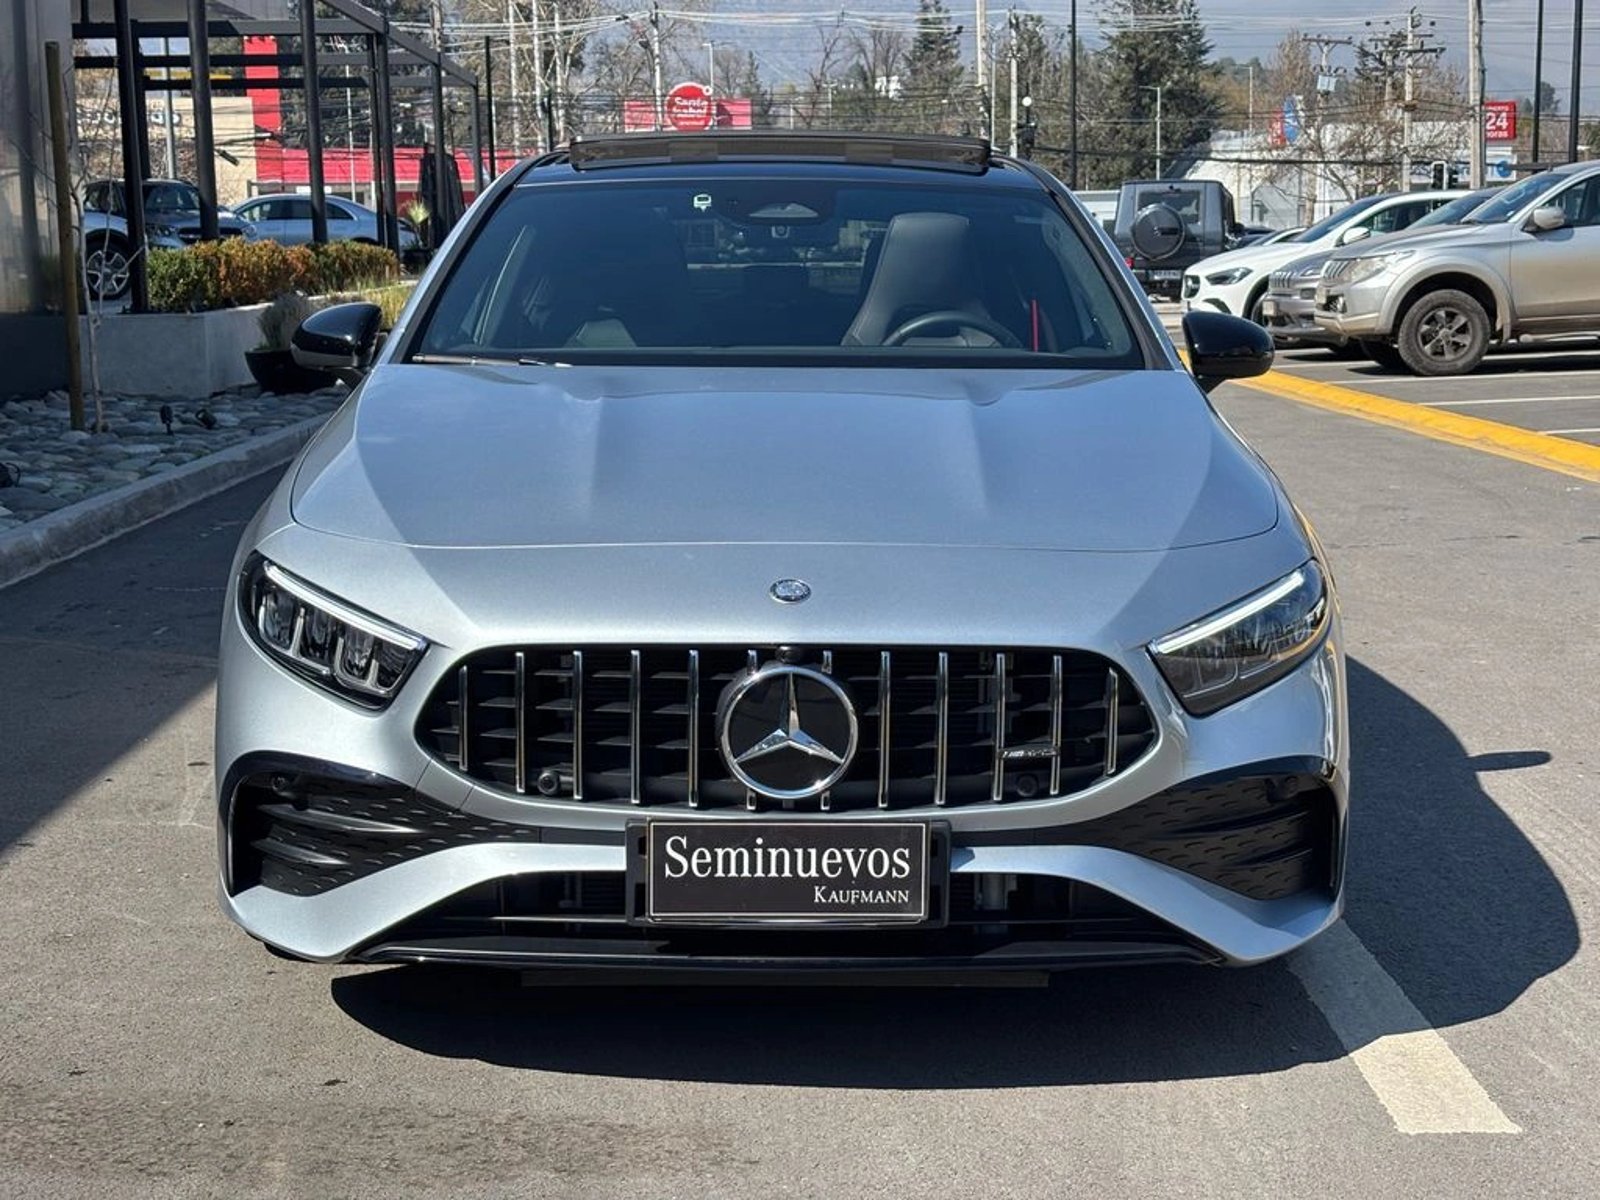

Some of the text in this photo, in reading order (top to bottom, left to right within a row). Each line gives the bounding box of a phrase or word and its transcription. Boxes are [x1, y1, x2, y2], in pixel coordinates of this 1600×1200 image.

[1485, 111, 1509, 130] 24
[664, 835, 911, 879] Seminuevos
[813, 885, 910, 904] KAUFMANN
